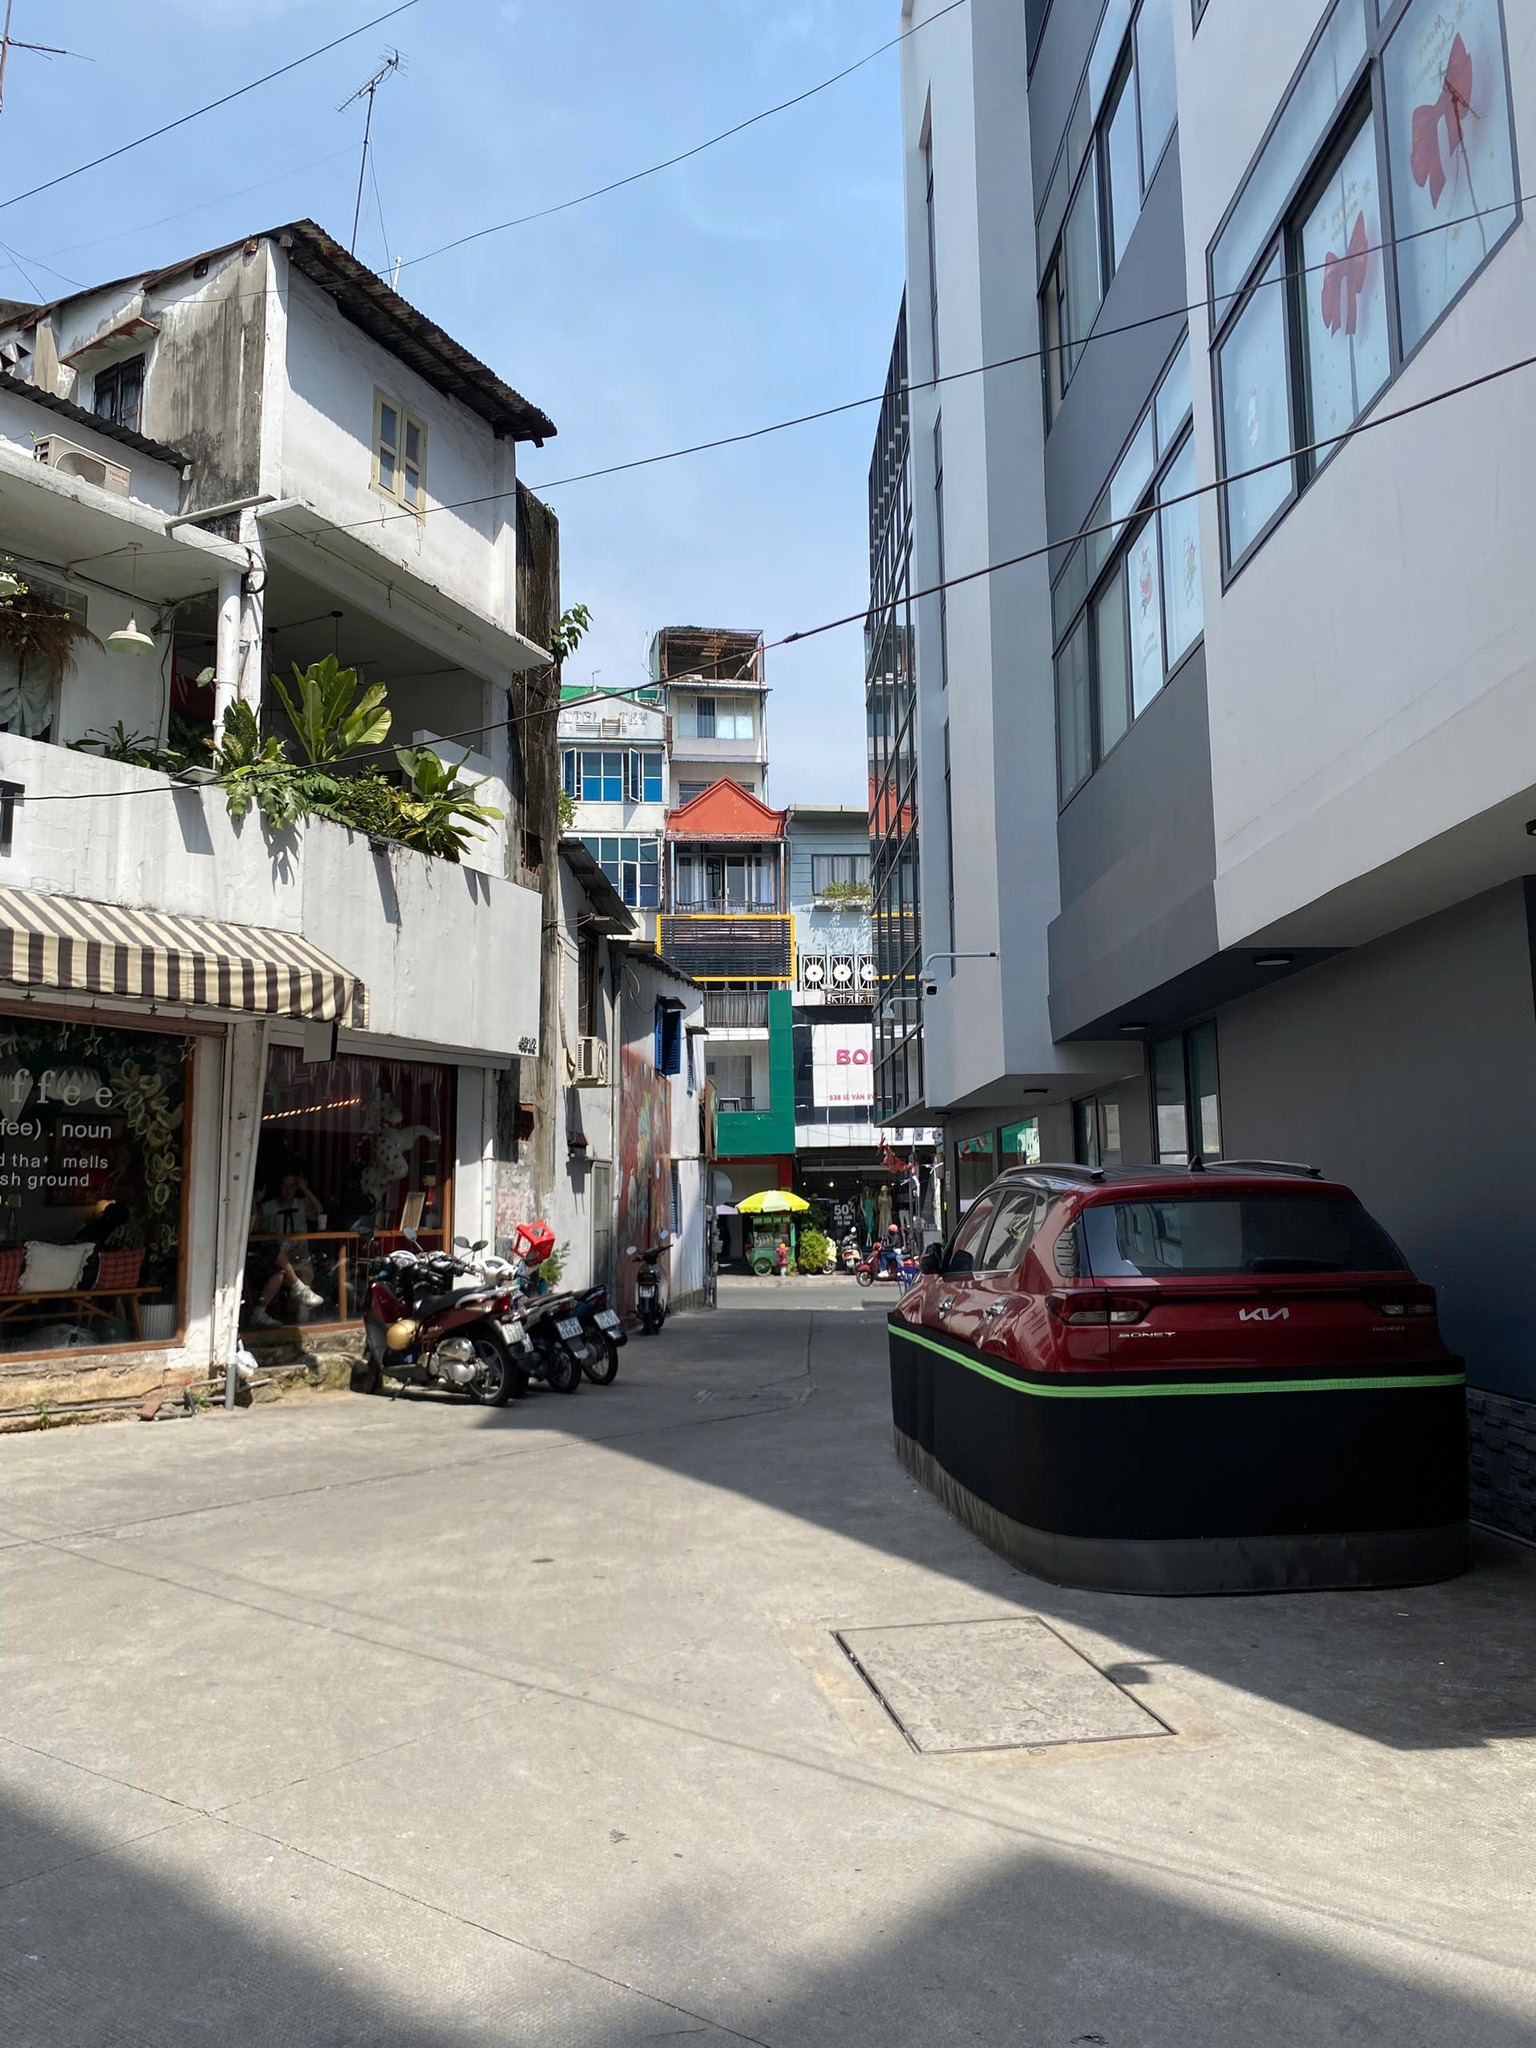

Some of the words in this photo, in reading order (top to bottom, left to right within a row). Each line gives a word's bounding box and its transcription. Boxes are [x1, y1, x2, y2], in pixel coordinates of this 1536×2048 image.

[836, 1049, 874, 1065] BO
[62, 1123, 112, 1139] noun
[28, 1173, 90, 1190] ground
[1239, 1307, 1289, 1321] KIA
